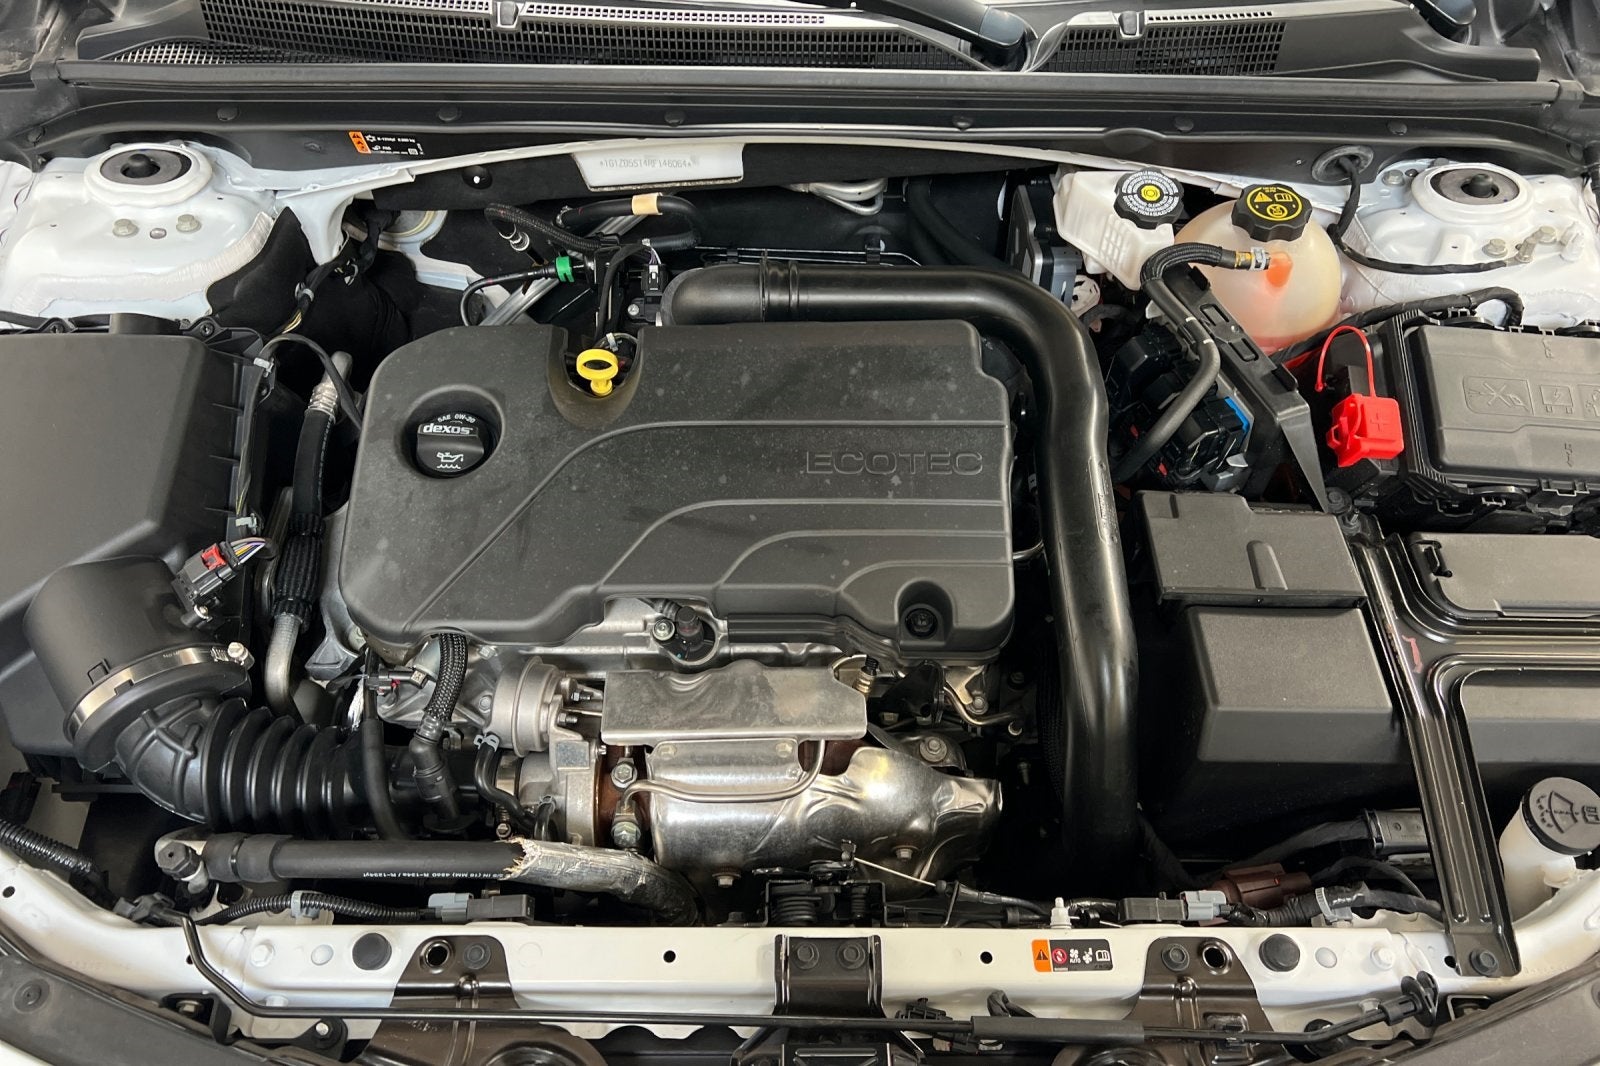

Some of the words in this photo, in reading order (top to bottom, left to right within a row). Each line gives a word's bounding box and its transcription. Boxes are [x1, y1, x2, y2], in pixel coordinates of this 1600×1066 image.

[437, 414, 451, 422] SAE
[423, 423, 473, 435] dexos
[806, 451, 983, 475] ECOTEC
